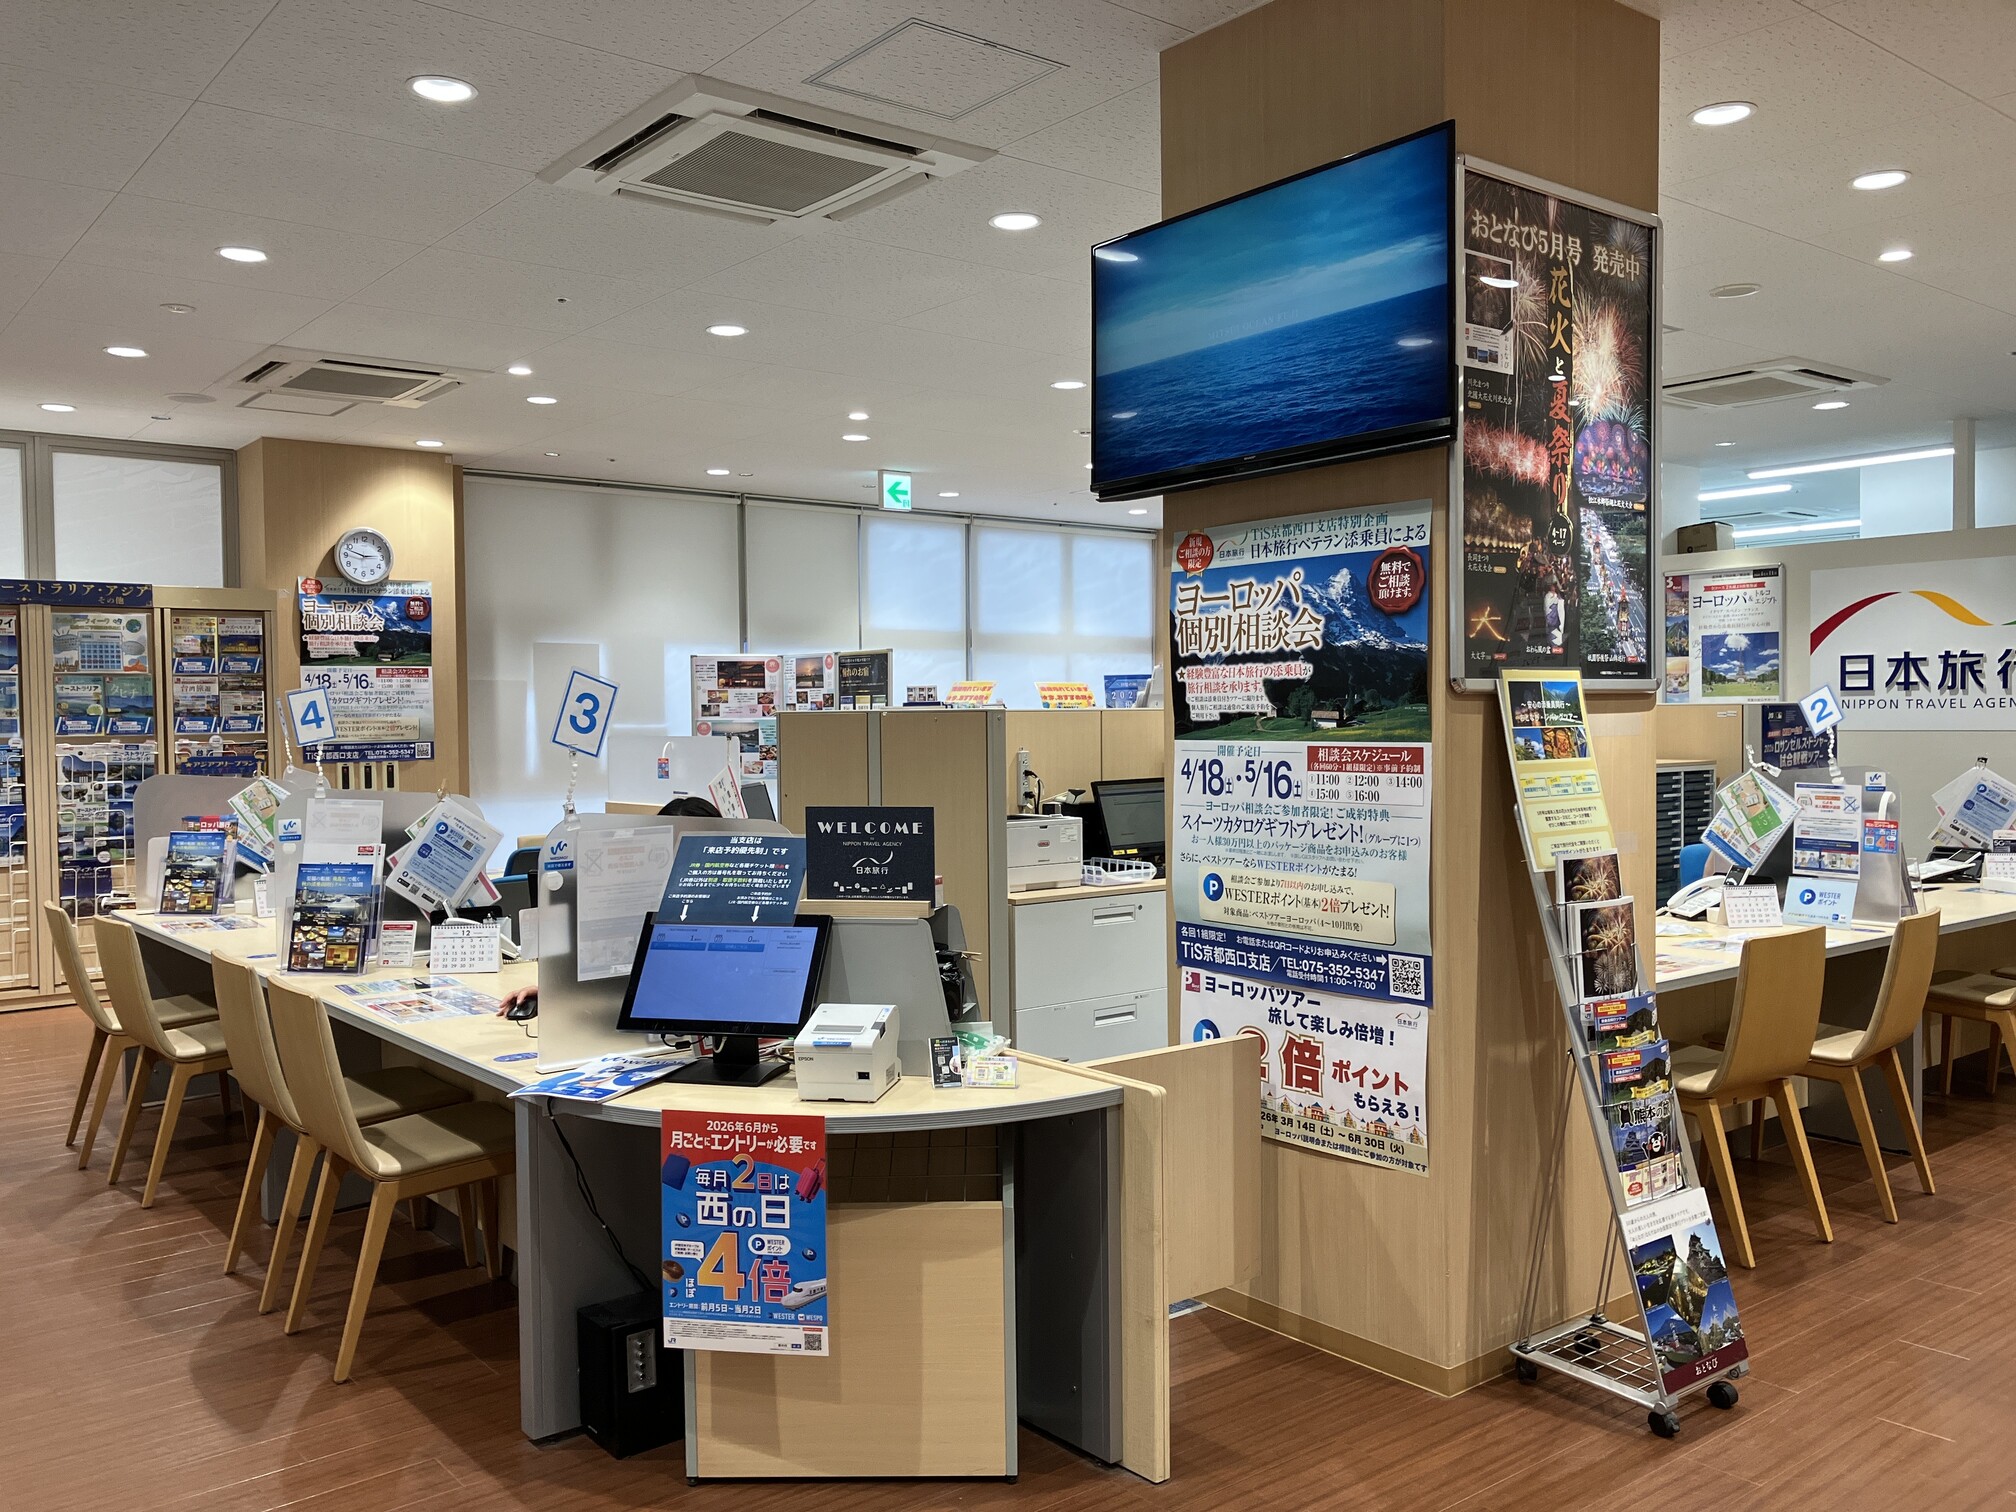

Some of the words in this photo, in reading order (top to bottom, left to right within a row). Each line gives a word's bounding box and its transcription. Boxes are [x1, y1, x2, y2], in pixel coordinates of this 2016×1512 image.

[1471, 209, 1583, 266] おとなび5月号
[1593, 245, 1640, 282] 発売中
[1548, 266, 1572, 506] 花火と夏祭り
[1250, 511, 1388, 542] TiS京都西口支店特別企画
[1250, 524, 1427, 559] 日本旅行ベテラン添乗員による
[1179, 546, 1211, 559] ご相談の方
[1220, 548, 1245, 558] 日本旅行
[1188, 559, 1201, 569] 限定
[1380, 560, 1411, 575] 無料で
[1378, 573, 1410, 588] ご相談
[98, 597, 124, 605] その他
[1178, 571, 1301, 616] ヨーロッパ
[1378, 587, 1412, 600] 頂けます。
[1693, 593, 1748, 609] ヨーロッパ
[1755, 589, 1771, 597] トルコ
[1755, 597, 1777, 605] エジプト
[303, 600, 374, 614] ヨーロッパ
[304, 614, 384, 630] 個別相談会
[1178, 607, 1323, 654] 個別相談会
[1186, 664, 1311, 680] 経験豊富な日本旅行の添乗員が
[110, 684, 139, 699] タヒチ
[1187, 681, 1264, 694] 旅行相談を承ります。
[1811, 698, 1833, 723] 2
[1841, 699, 1899, 709] NIPPON
[1906, 698, 1966, 709] TRAVEL
[300, 700, 325, 729] 4
[569, 692, 600, 735] 3
[1217, 745, 1261, 758] 開催予定日
[1317, 748, 1412, 762] 相談会スケジュール
[817, 821, 923, 836] WELCOME
[1181, 814, 1363, 843] スイーツカタログギフトプレゼント!
[730, 836, 763, 844] 当支店は
[1191, 835, 1408, 861] お一人様30万円以上のパッケージ商品をお申込みのお客様
[702, 847, 788, 855] 「来店予約優先制」です
[856, 866, 889, 875] 日本旅行
[1179, 853, 1357, 878] さらに、ベストツアーならWESTERポイントがたまる!
[1230, 874, 1354, 895] 相談会ご参加より7日以内のお申し込みで、
[1225, 888, 1389, 919] WESTERポイント(基本)2倍プレゼント!
[1819, 891, 1841, 899] WESTER
[1181, 926, 1226, 943] 各回1組限定!
[1236, 935, 1376, 963] お電話またはQRコードよりお申込みください
[1204, 975, 1321, 1008] ヨーロッパツアー
[1268, 1007, 1395, 1046] 旅して楽しみ倍増!
[1397, 1019, 1418, 1027] 日本旅行
[1332, 1060, 1409, 1096] ポイント
[1353, 1092, 1420, 1122] もらえる!
[706, 1120, 778, 1134] 2026年6月から
[1281, 1117, 1293, 1127] 3月
[1297, 1120, 1316, 1134] 14日
[1348, 1133, 1361, 1144] 6月
[1364, 1137, 1385, 1150] 30日
[670, 1130, 817, 1154] 月ごとにエントリーが必要です
[695, 1153, 790, 1191] 毎月2日は
[695, 1191, 791, 1229] 西の日
[697, 1231, 792, 1304] 4倍
[685, 1278, 697, 1298] ほぼ
[1695, 1357, 1718, 1376] おとなび
